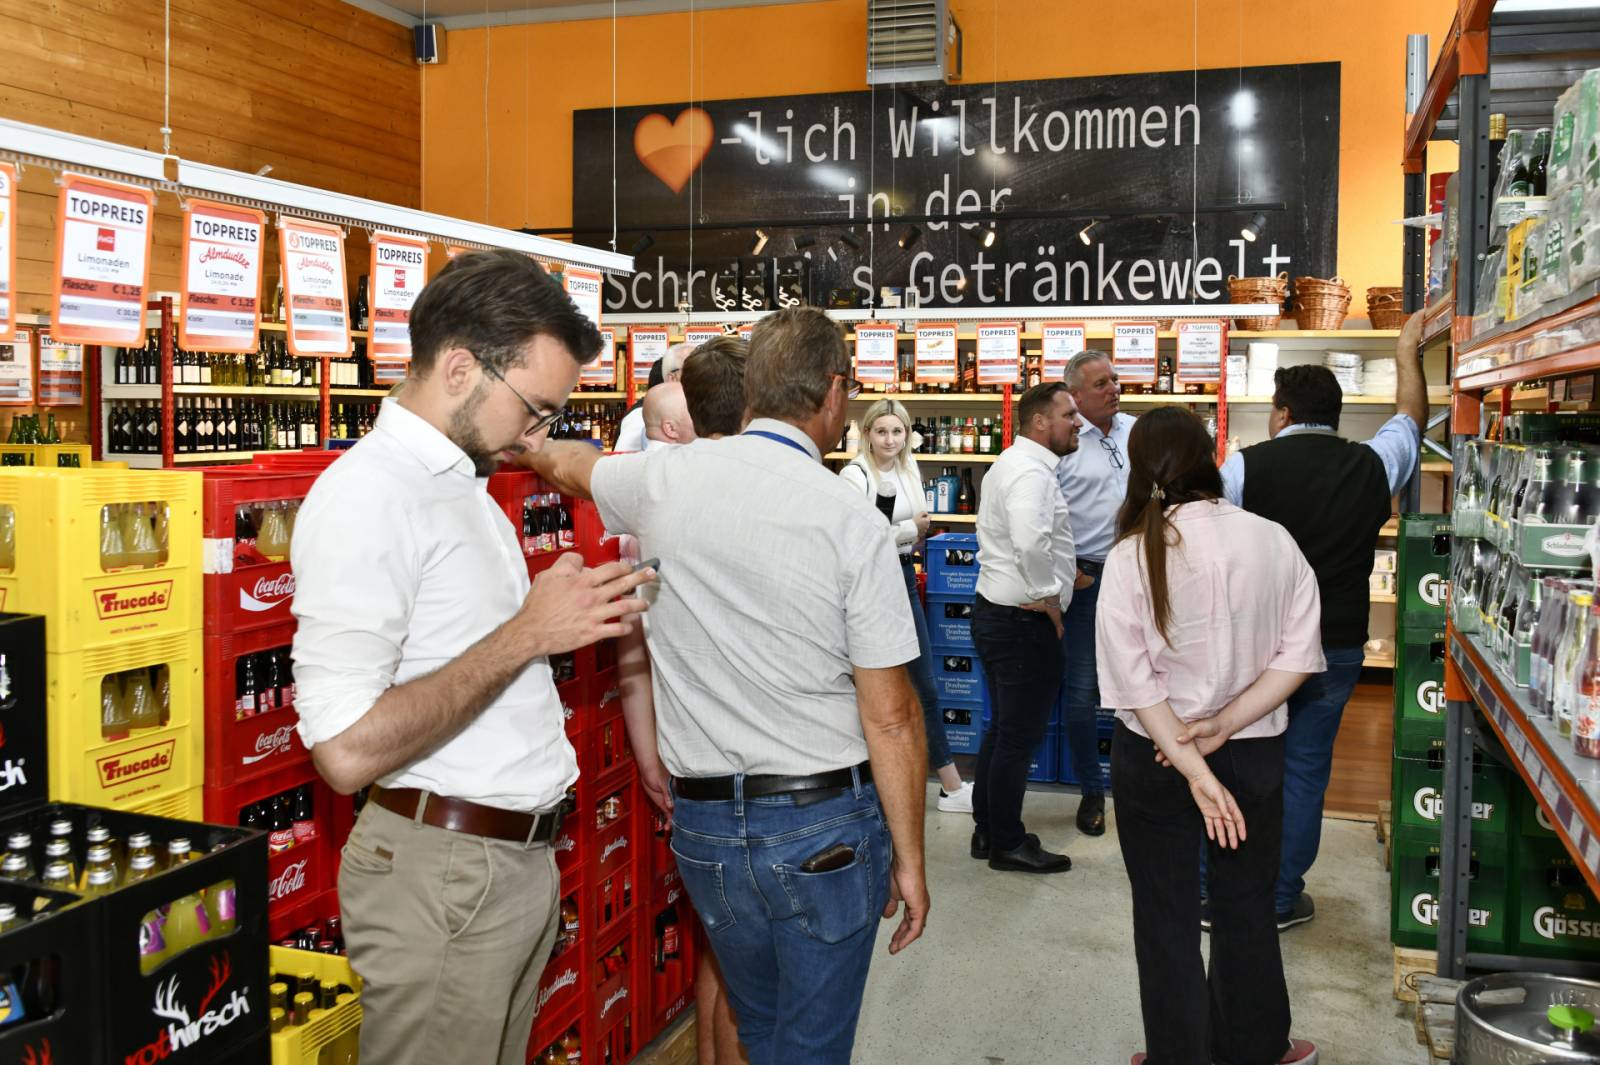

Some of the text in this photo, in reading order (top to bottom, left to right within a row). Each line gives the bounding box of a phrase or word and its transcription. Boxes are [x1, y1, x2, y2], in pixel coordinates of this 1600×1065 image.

[889, 96, 1200, 159] Willkommen
[71, 197, 144, 224] TOPPREIS
[838, 173, 1013, 233] in der
[195, 220, 257, 242] TOPPREIS
[299, 235, 337, 252] TOPPREIS
[78, 253, 130, 269] Limonaden
[199, 246, 250, 269] Almdudler
[378, 247, 422, 264] TOPPREIS
[205, 269, 244, 282] Limonade
[910, 239, 1292, 304] Getränkewelt
[570, 280, 599, 293] TOPPREIS
[100, 591, 165, 613] Frucade
[103, 753, 168, 781] Frucade
